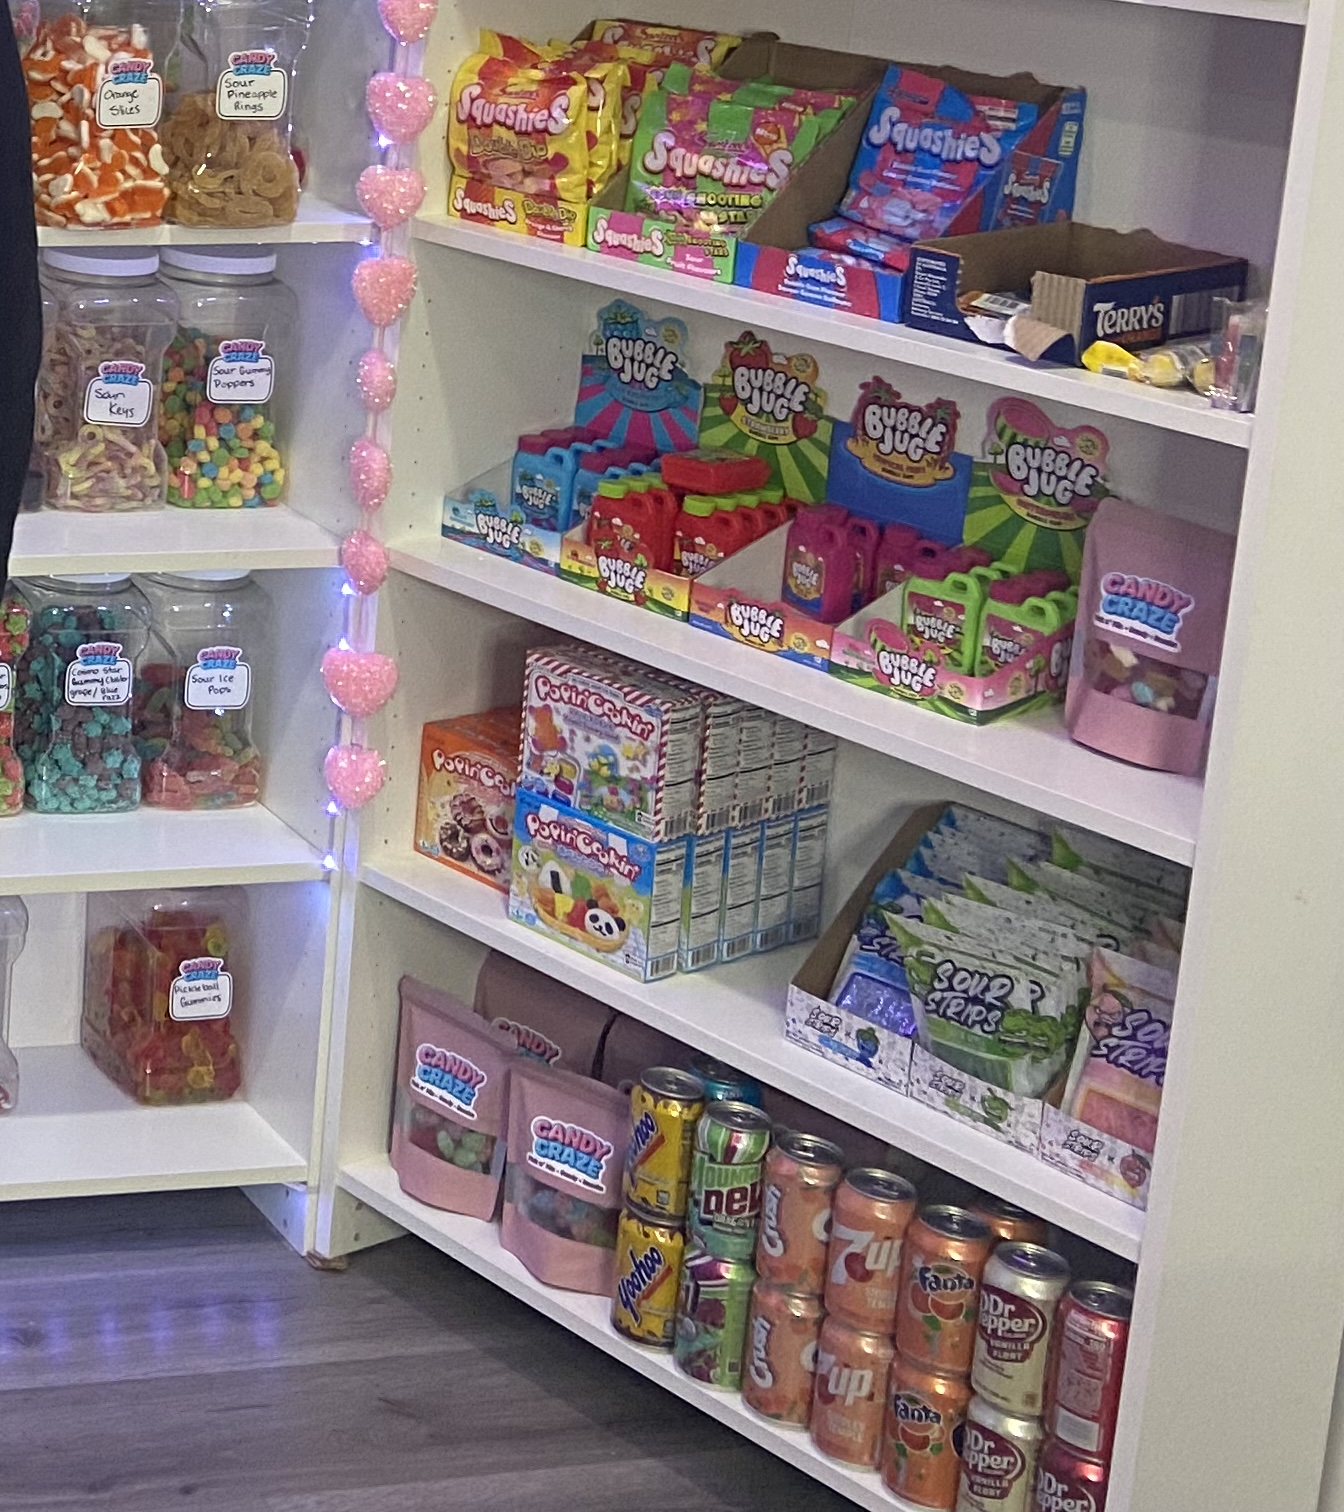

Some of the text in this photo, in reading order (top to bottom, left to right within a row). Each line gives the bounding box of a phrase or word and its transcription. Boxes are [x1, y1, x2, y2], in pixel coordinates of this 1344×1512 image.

[224, 77, 256, 89] Sour
[457, 81, 569, 135] Squashies
[869, 107, 1002, 167] Squashies
[644, 131, 793, 189] Squashies
[454, 187, 516, 224] Squashies
[594, 217, 664, 257] Squashies
[213, 365, 237, 376] Sour
[606, 336, 678, 381] BUBBLE
[619, 361, 660, 389] JUG
[734, 366, 811, 414] BUBBLE
[748, 388, 791, 422] JUG
[864, 403, 948, 454] BUBBLE
[878, 427, 924, 462] JUG
[1006, 442, 1099, 497] BUBBLE
[1022, 467, 1074, 505] JUG
[476, 512, 523, 545] BUBBLE
[598, 554, 647, 590] BUBBLE
[608, 570, 636, 594] JUG
[1102, 573, 1193, 611] CANDY
[730, 602, 785, 638] BUBBLE
[740, 618, 772, 644] JUG
[1102, 594, 1180, 635] CRAZE
[192, 675, 216, 685] Sour
[878, 648, 937, 690] BUBBLE
[890, 666, 923, 692] JUG
[933, 958, 1014, 1008] SOUR
[924, 988, 1002, 1034] STRIPS
[418, 1045, 485, 1087] CANDY
[417, 1064, 476, 1107] CRAZE
[533, 1118, 613, 1162] CANDY
[534, 1137, 604, 1180] CRAZE
[762, 1184, 787, 1258] Crush
[918, 1267, 975, 1297] Fanta
[990, 1294, 1016, 1318] Dr
[750, 1315, 773, 1388] Crush
[971, 1431, 995, 1454] Dr
[1043, 1472, 1068, 1495] Dr
